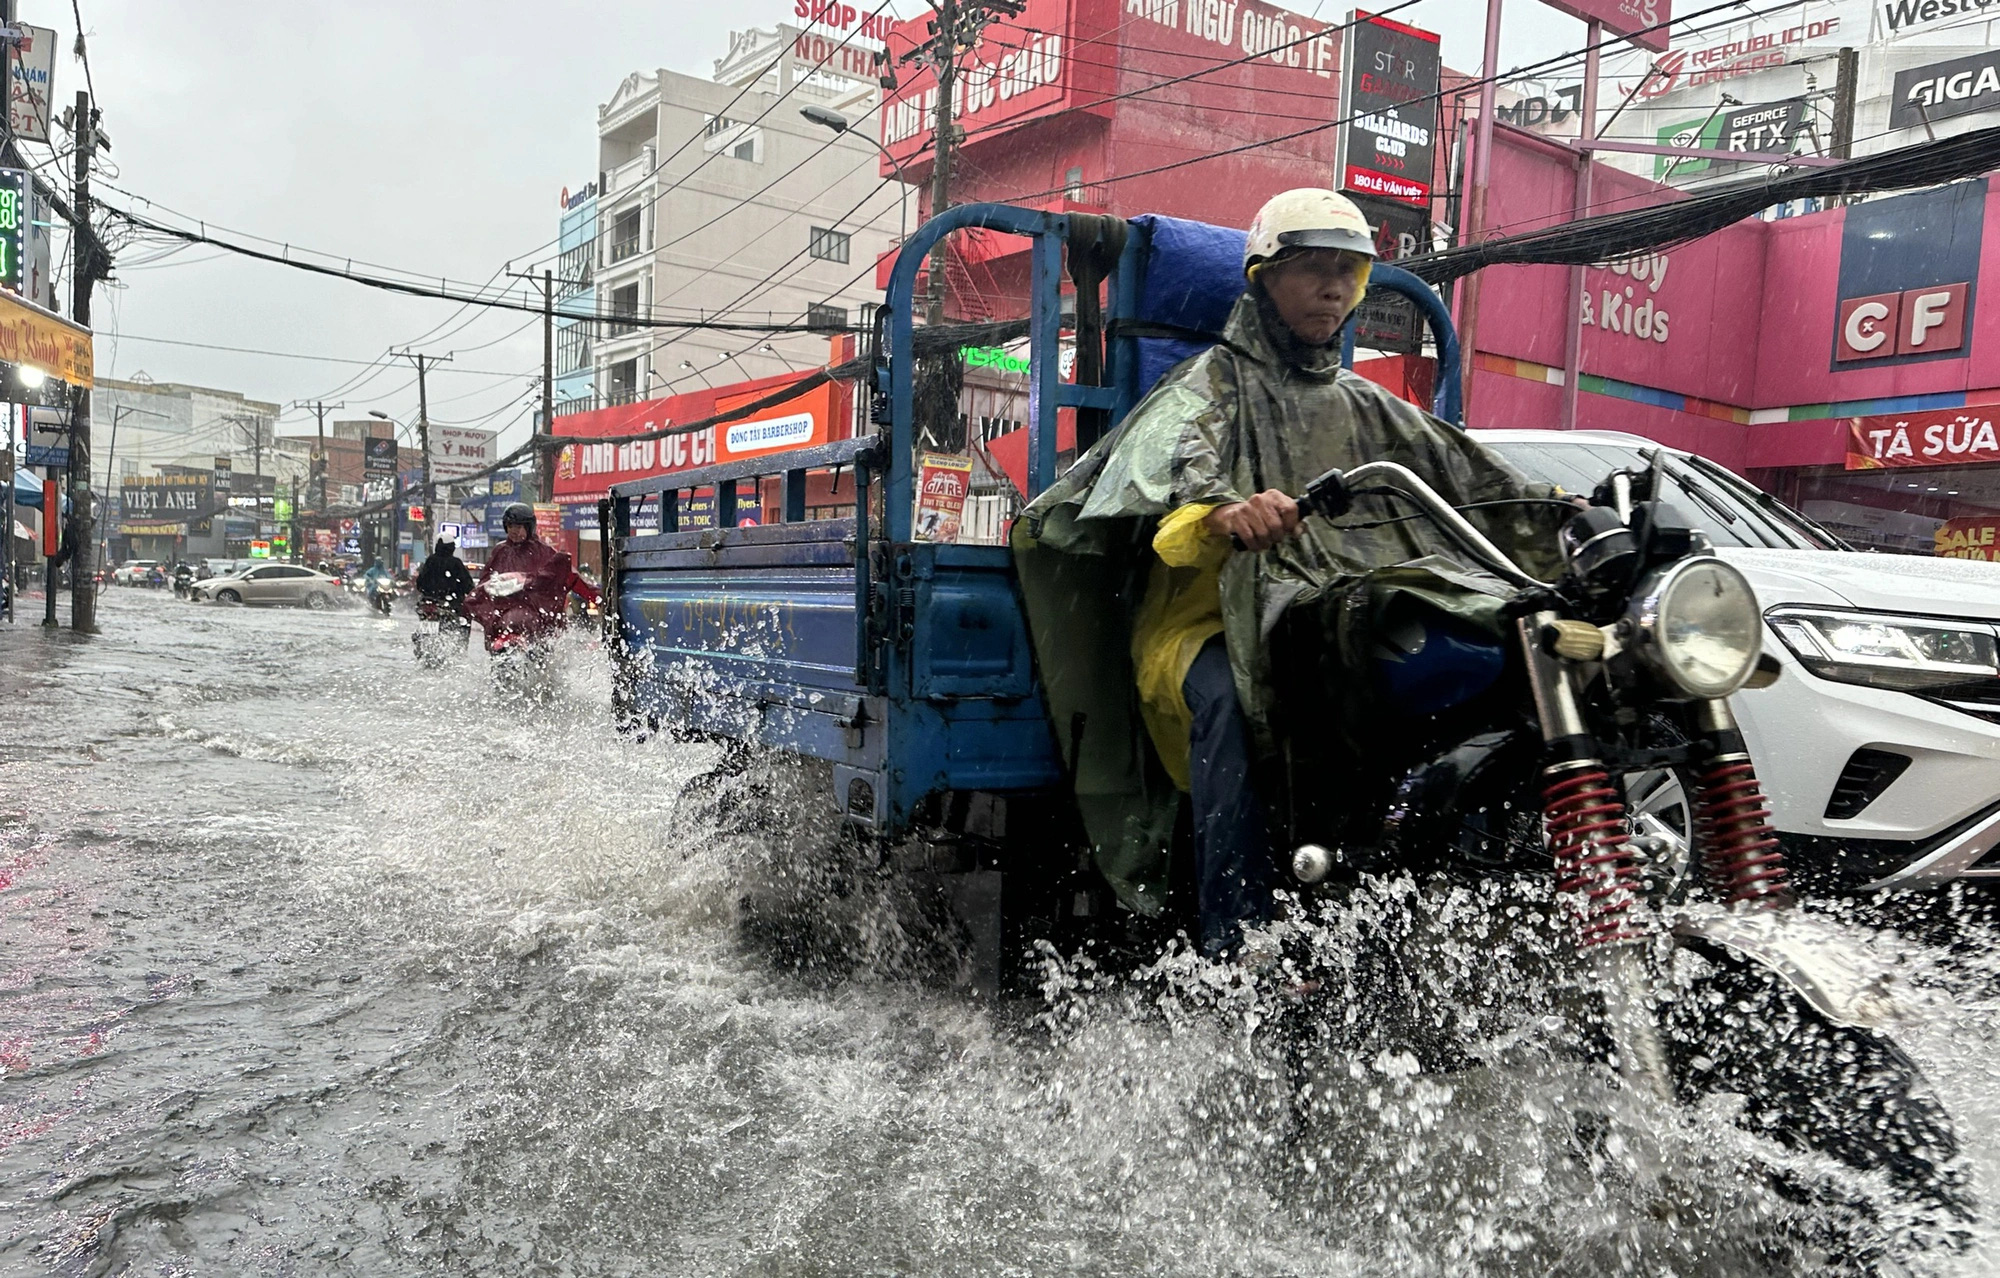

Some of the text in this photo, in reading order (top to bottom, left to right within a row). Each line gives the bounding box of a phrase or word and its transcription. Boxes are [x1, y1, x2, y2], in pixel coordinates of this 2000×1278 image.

[795, 0, 857, 31] SHOP
[1618, 2, 1640, 19] .com
[1241, 9, 1300, 68] QUỐC
[1305, 22, 1334, 79] TẾ
[1692, 17, 1840, 67] REPUBLIC OF
[1688, 52, 1786, 88] GAMERS
[884, 92, 922, 147] ANH
[1000, 33, 1063, 101] CHÂU
[1907, 65, 2000, 107] GIGA
[1497, 96, 1549, 126] MD
[1732, 106, 1789, 128] GEFORCE
[1353, 109, 1429, 147] BILLIARDS
[1728, 121, 1788, 152] RTX
[1375, 135, 1406, 158] CLUB
[1354, 174, 1423, 202] 180 LÊ VĂN VIỆT
[1601, 285, 1669, 343] Kids
[442, 429, 462, 437] SHOP
[762, 420, 808, 440] BARBERSHOP
[1869, 416, 1999, 459] TÃ SỮA
[442, 440, 486, 459] Ý NHI
[581, 442, 615, 475] ANH
[618, 421, 657, 471] NGỮ
[125, 486, 197, 514] VIỆT ANH
[738, 498, 755, 512] Flyers
[694, 515, 712, 527] TOEIC
[1934, 525, 1996, 552] SALE
